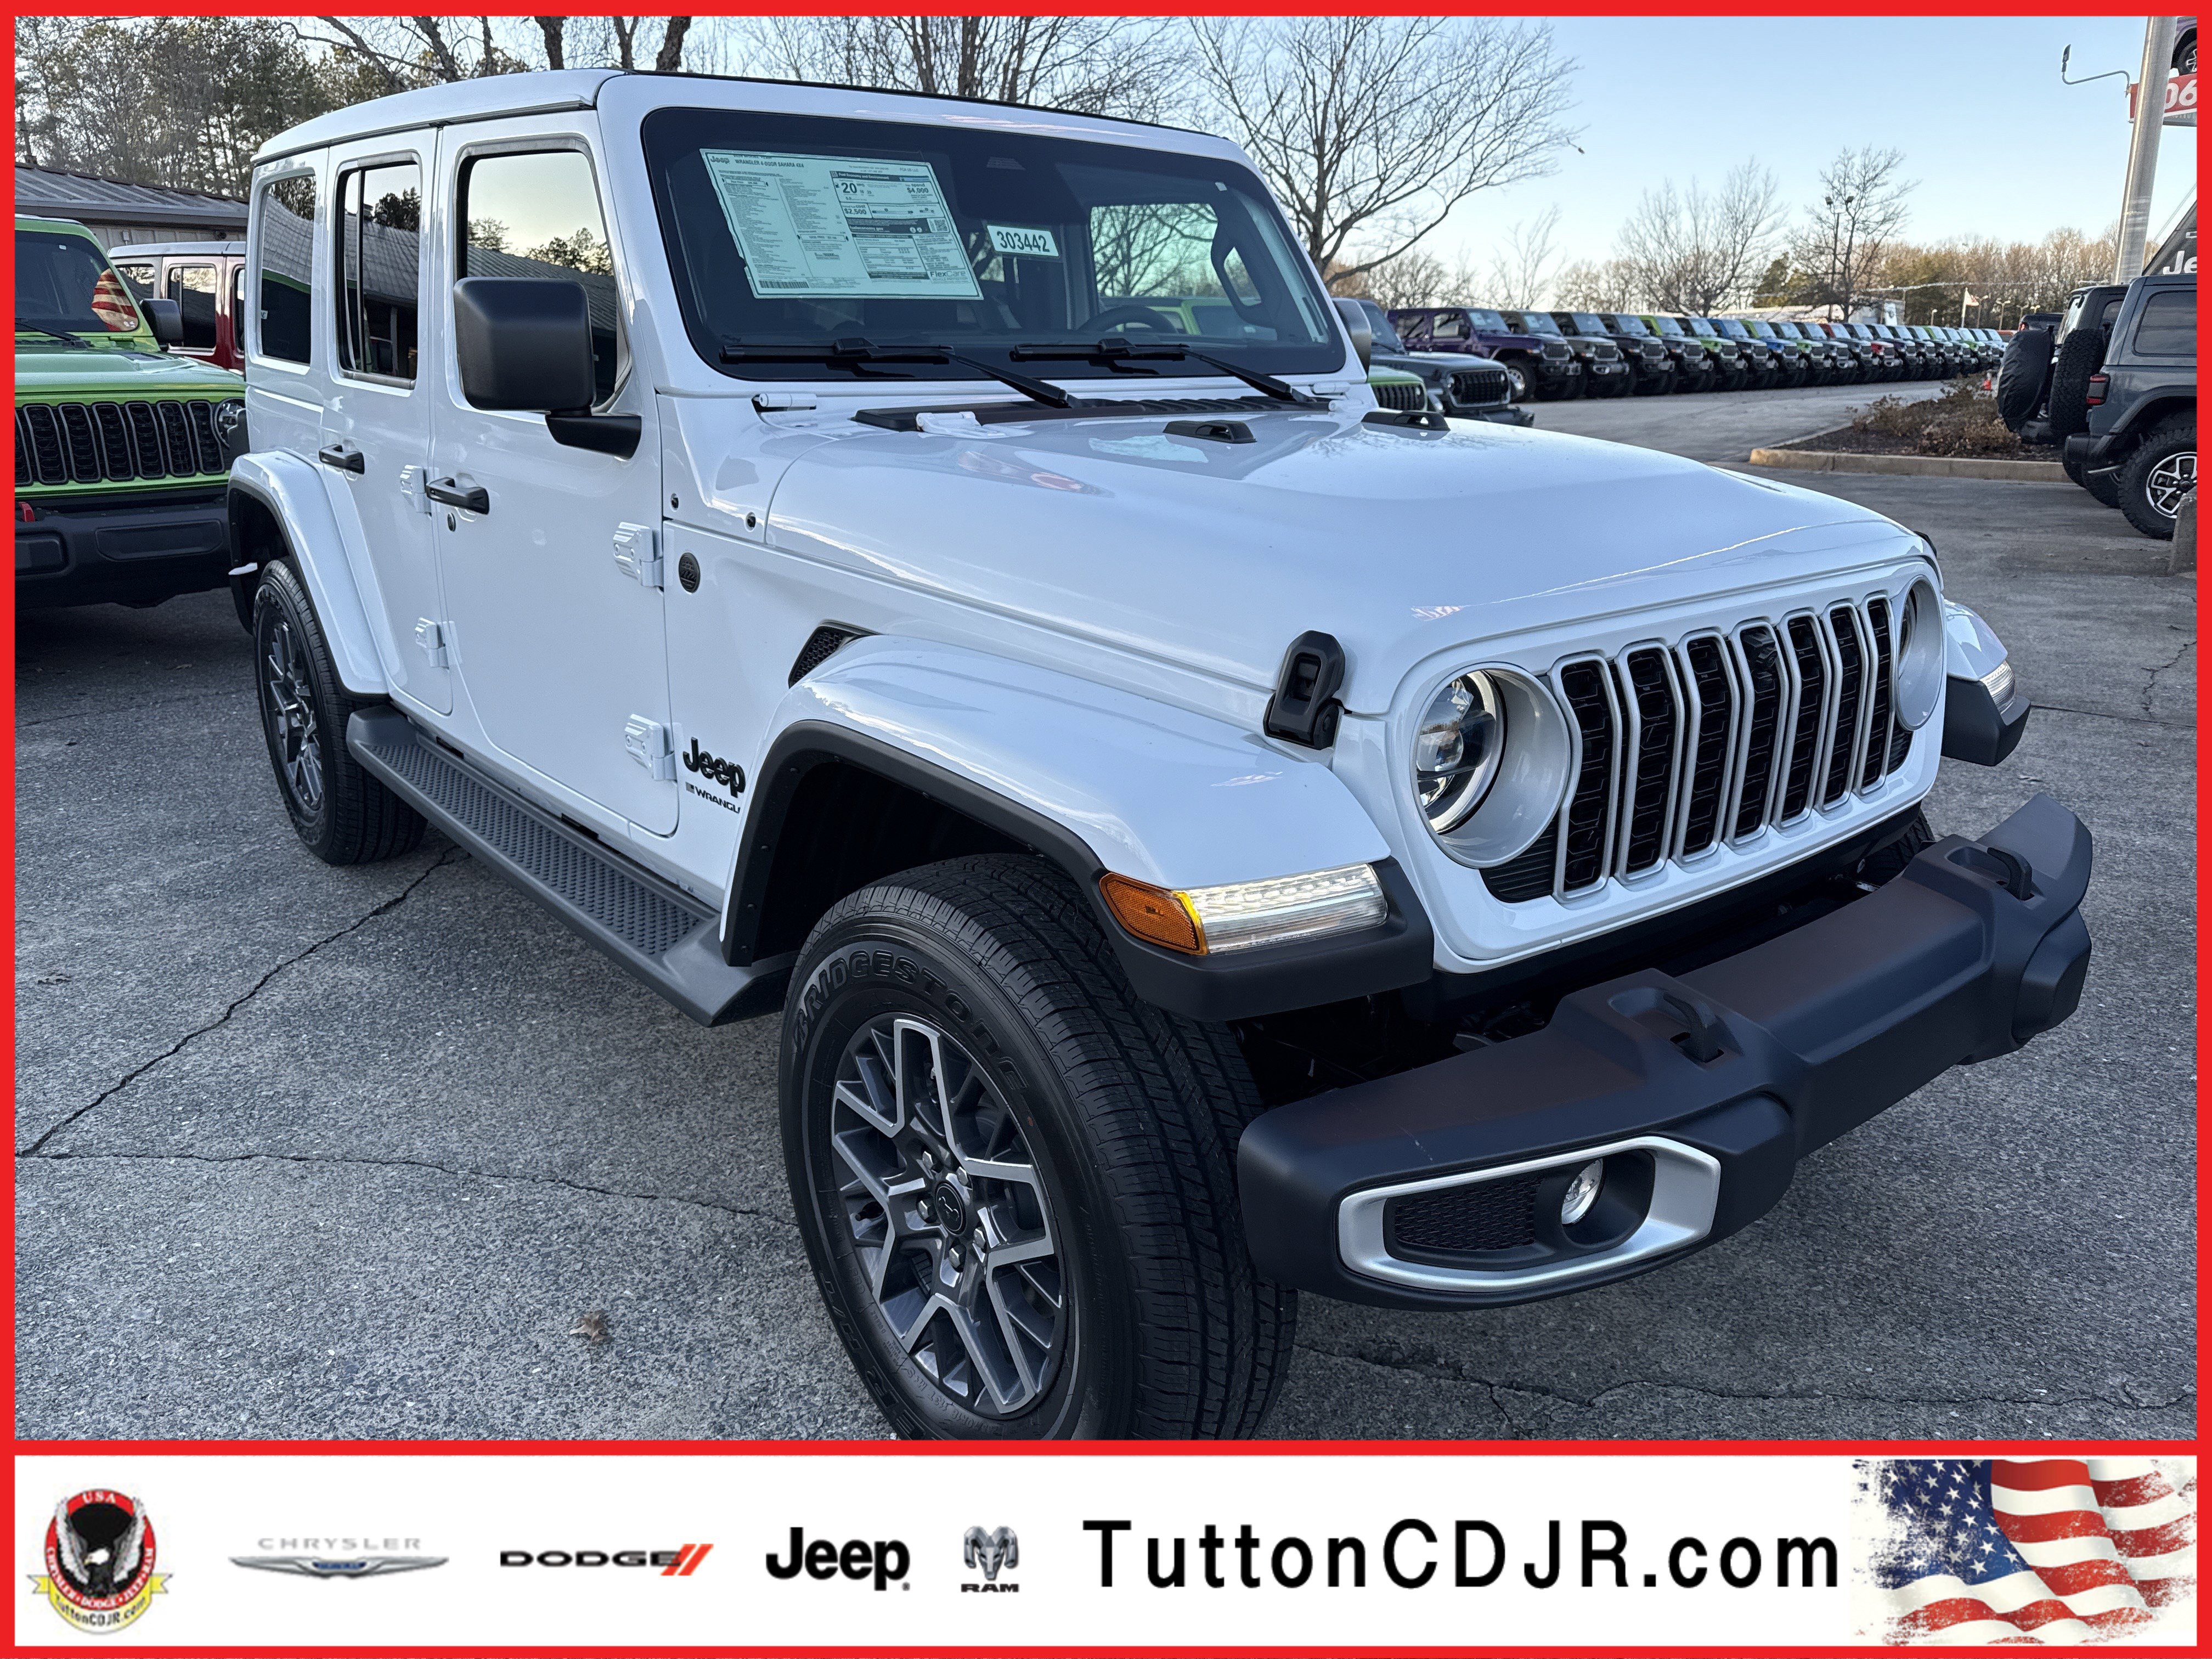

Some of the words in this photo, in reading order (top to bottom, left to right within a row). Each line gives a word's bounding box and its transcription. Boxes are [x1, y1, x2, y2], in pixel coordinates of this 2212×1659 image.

[841, 182, 857, 194] 20
[997, 231, 1050, 252] 303442
[683, 737, 746, 799] Jeep
[793, 950, 1029, 1091] BRIDGESTONE
